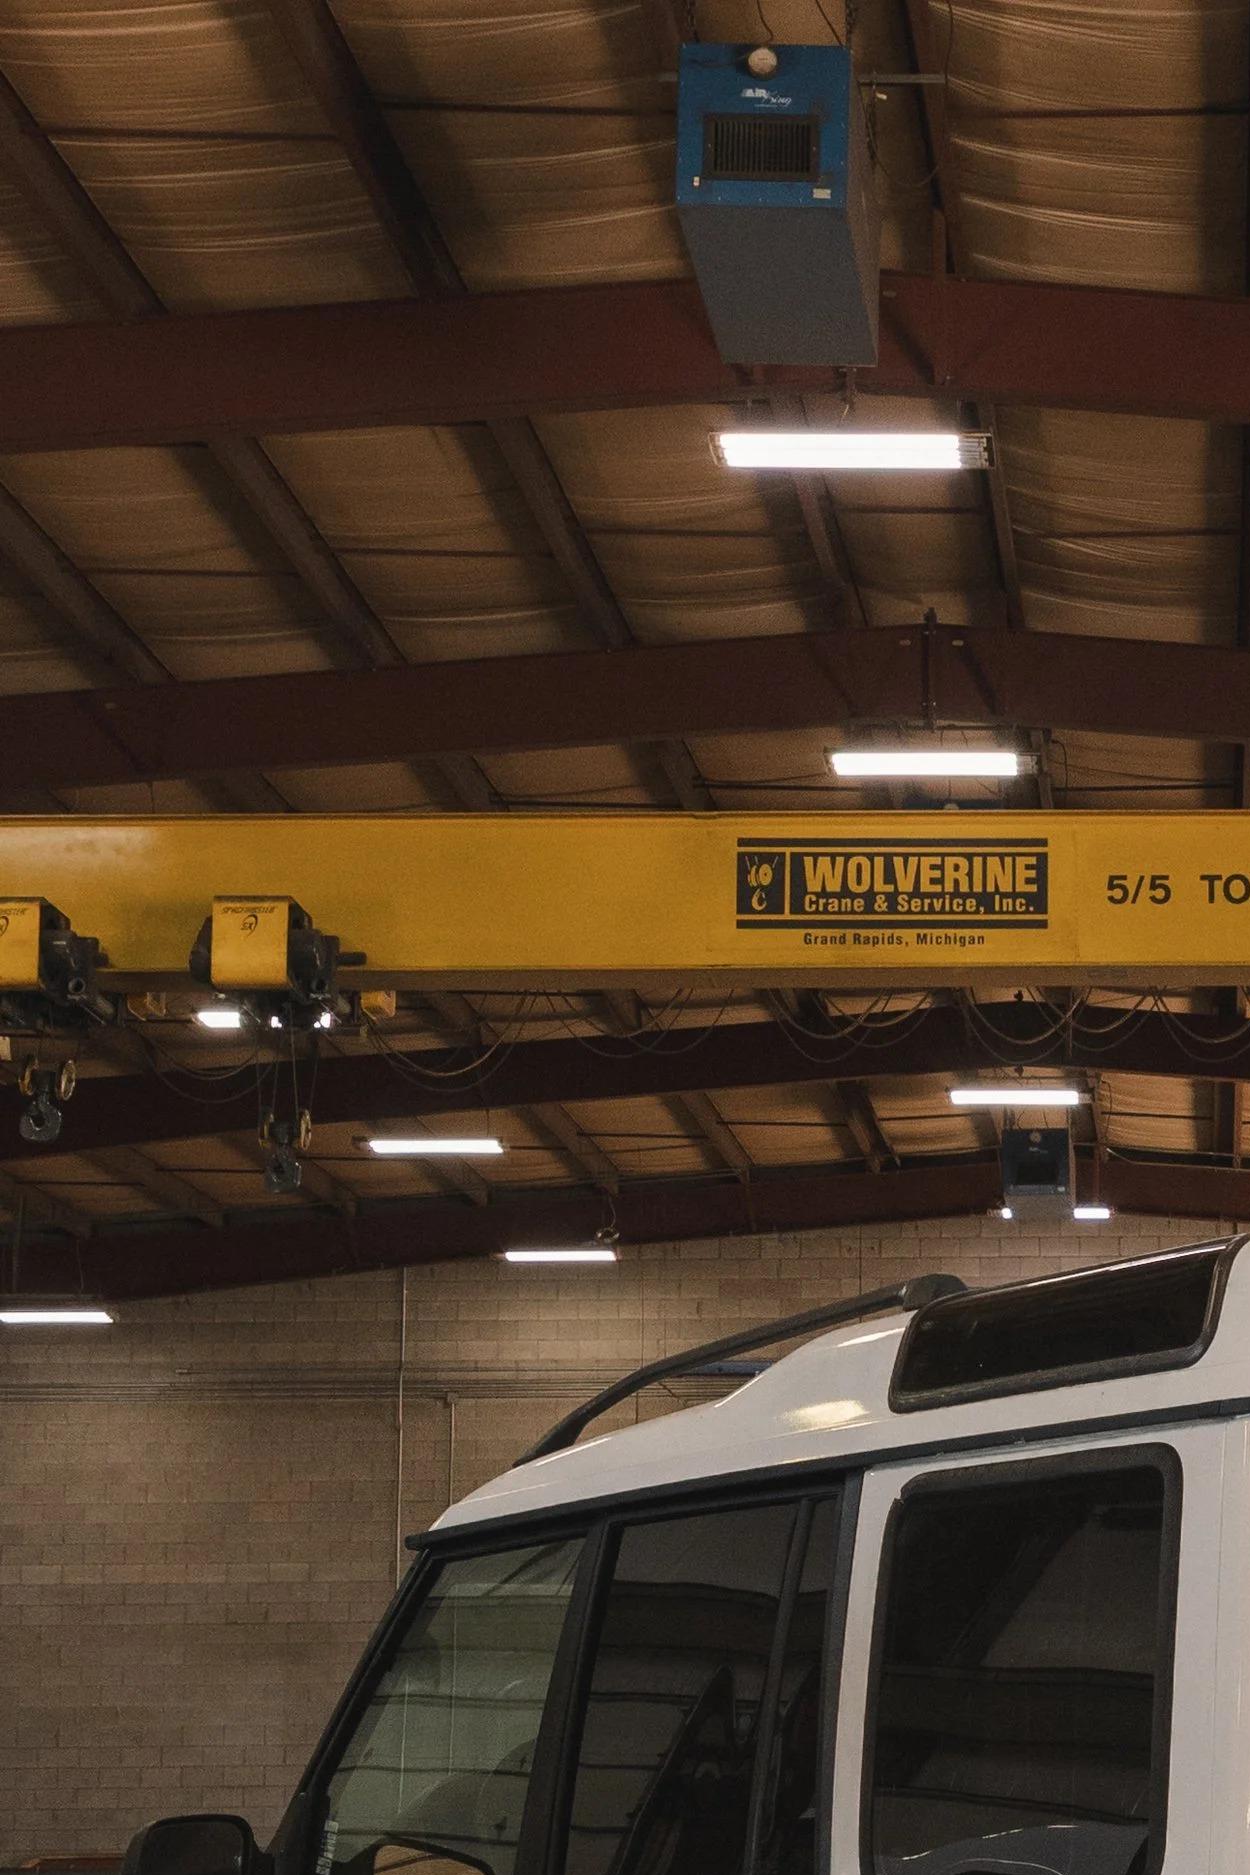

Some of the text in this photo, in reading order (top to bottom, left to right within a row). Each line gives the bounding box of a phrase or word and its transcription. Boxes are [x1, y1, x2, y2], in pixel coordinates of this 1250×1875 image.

[803, 856, 1038, 893] WOLVERINE
[1106, 874, 1172, 905] 5/5
[804, 895, 1034, 914] Crane & Service, Inc.
[803, 932, 985, 947] Grand Rapids, Michigan
